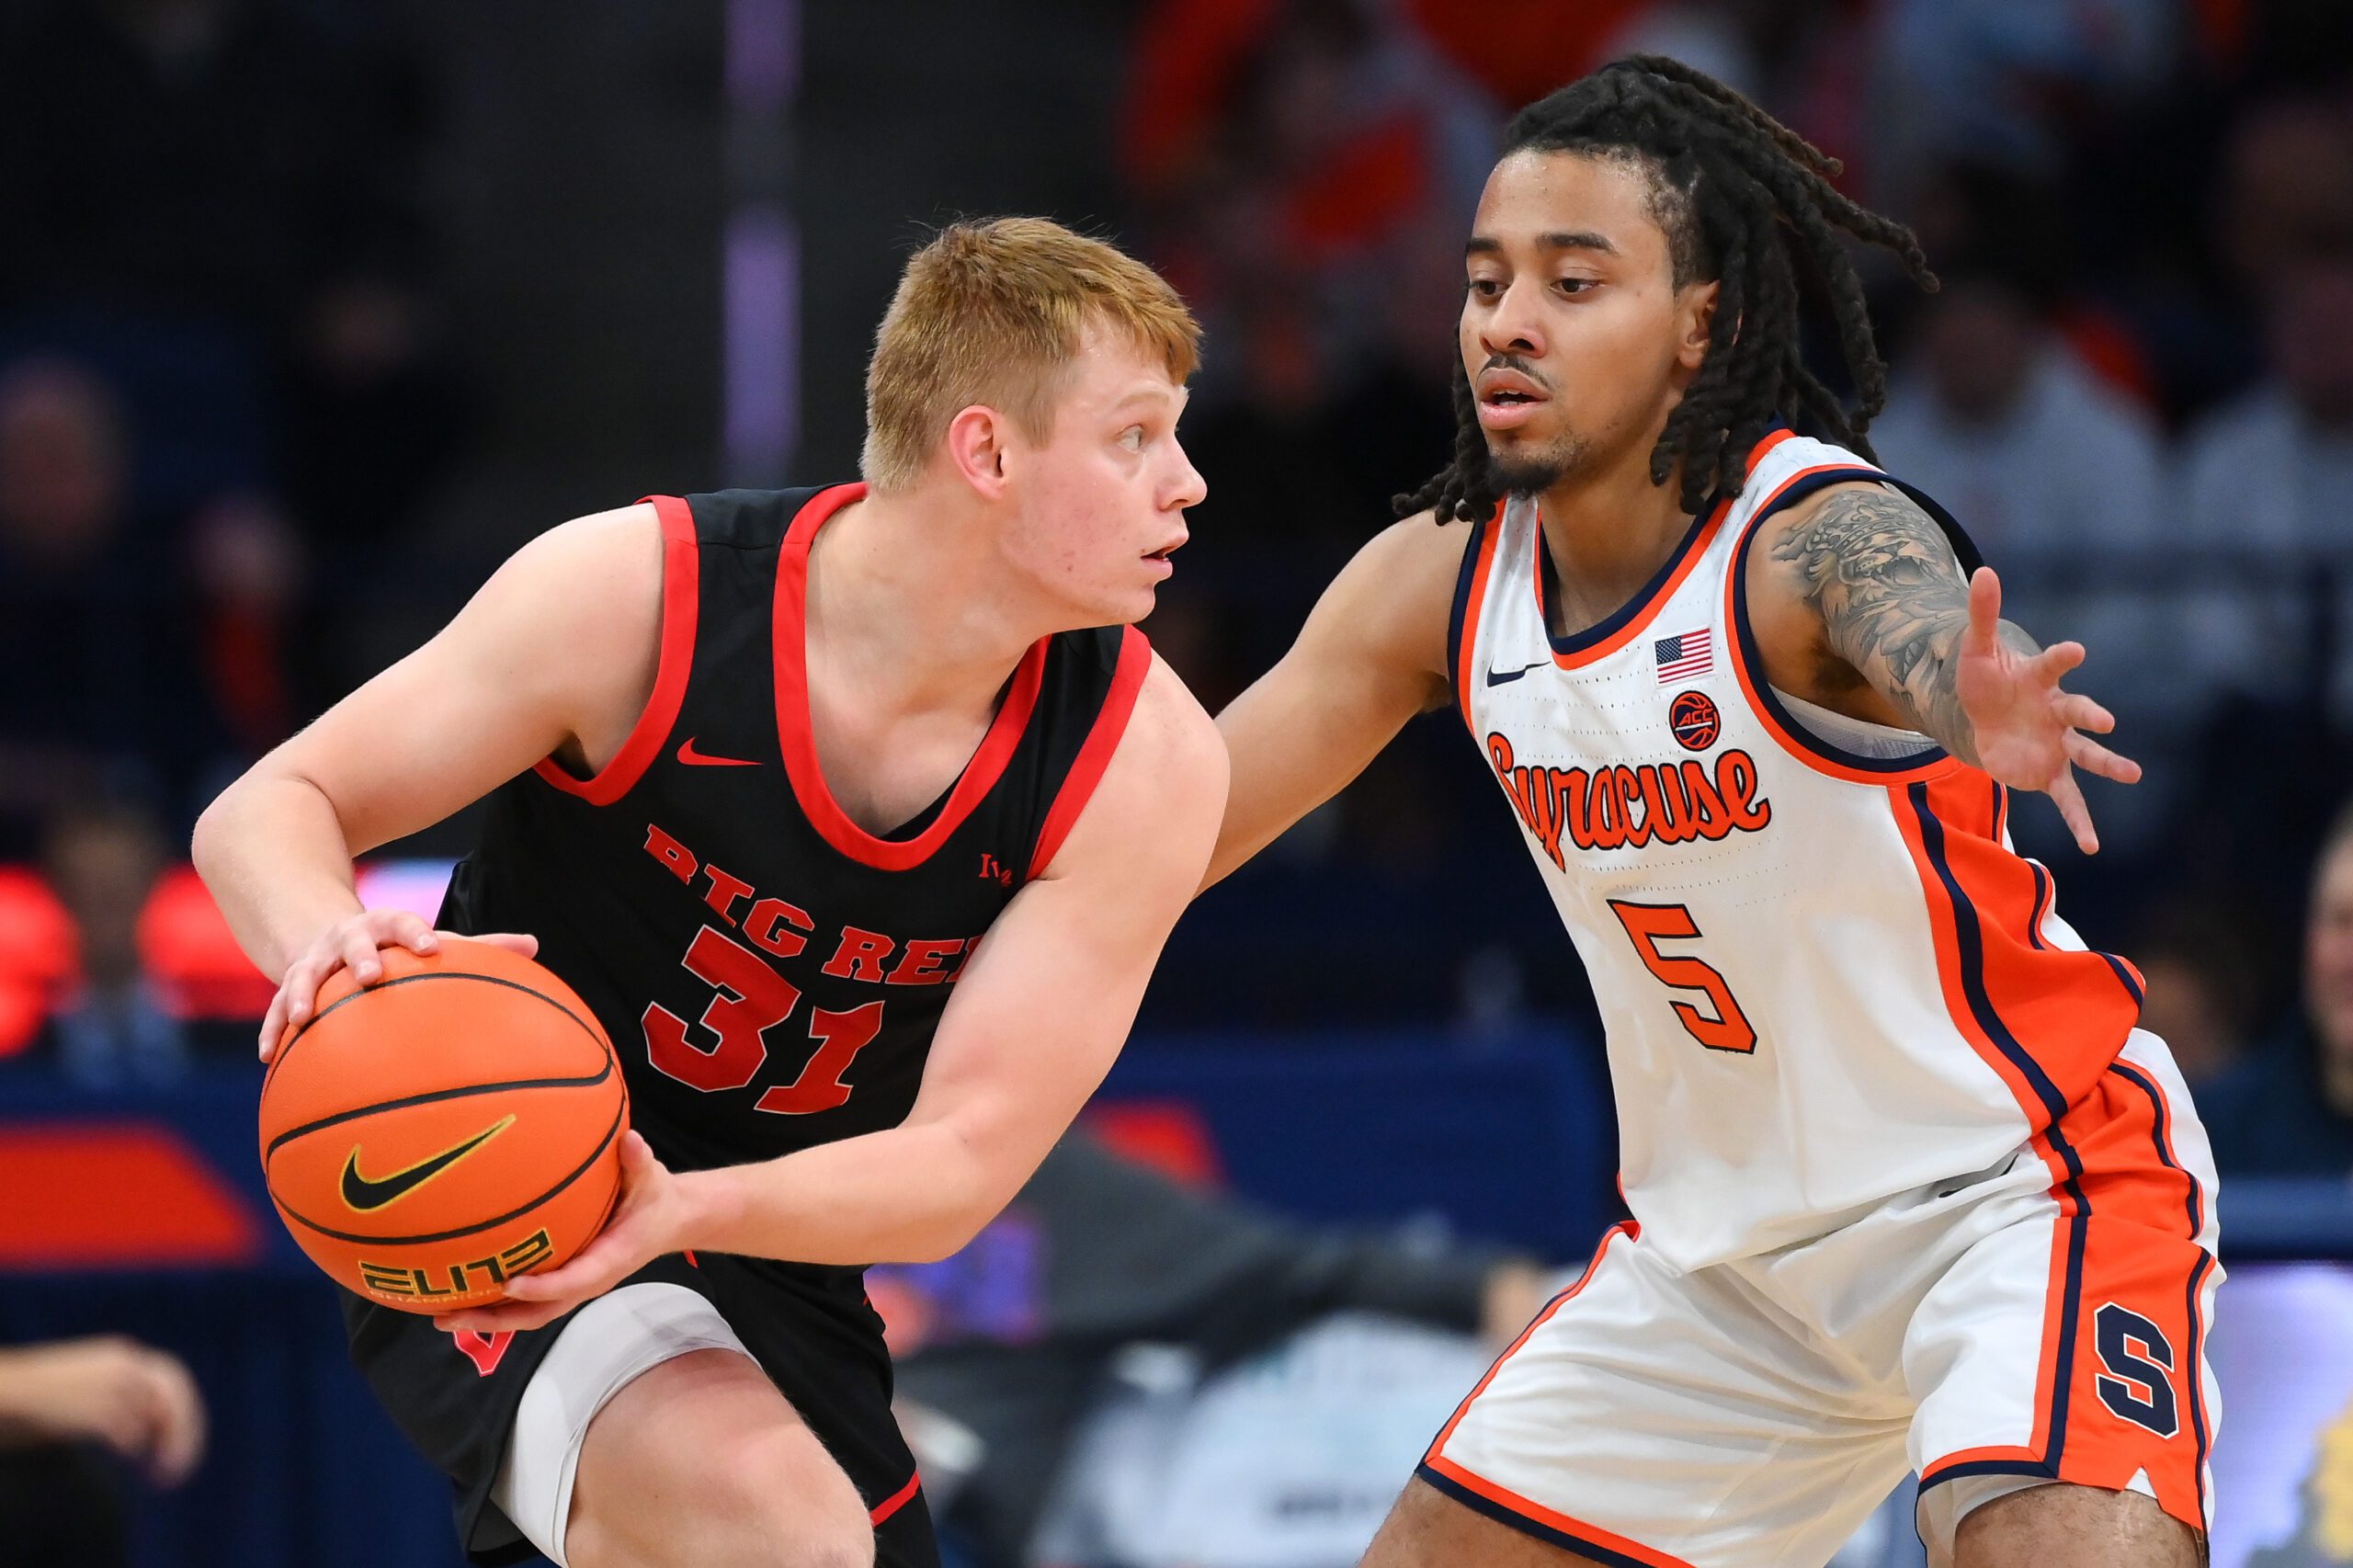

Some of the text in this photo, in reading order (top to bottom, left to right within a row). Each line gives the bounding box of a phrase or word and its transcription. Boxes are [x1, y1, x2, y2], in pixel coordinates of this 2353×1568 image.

[1678, 708, 1713, 726] ACC
[1487, 732, 1771, 874] Syracuse
[641, 924, 886, 1115] 31
[1606, 899, 1757, 1054] 5
[358, 1227, 553, 1297] ELITE
[2093, 1301, 2180, 1440] S
